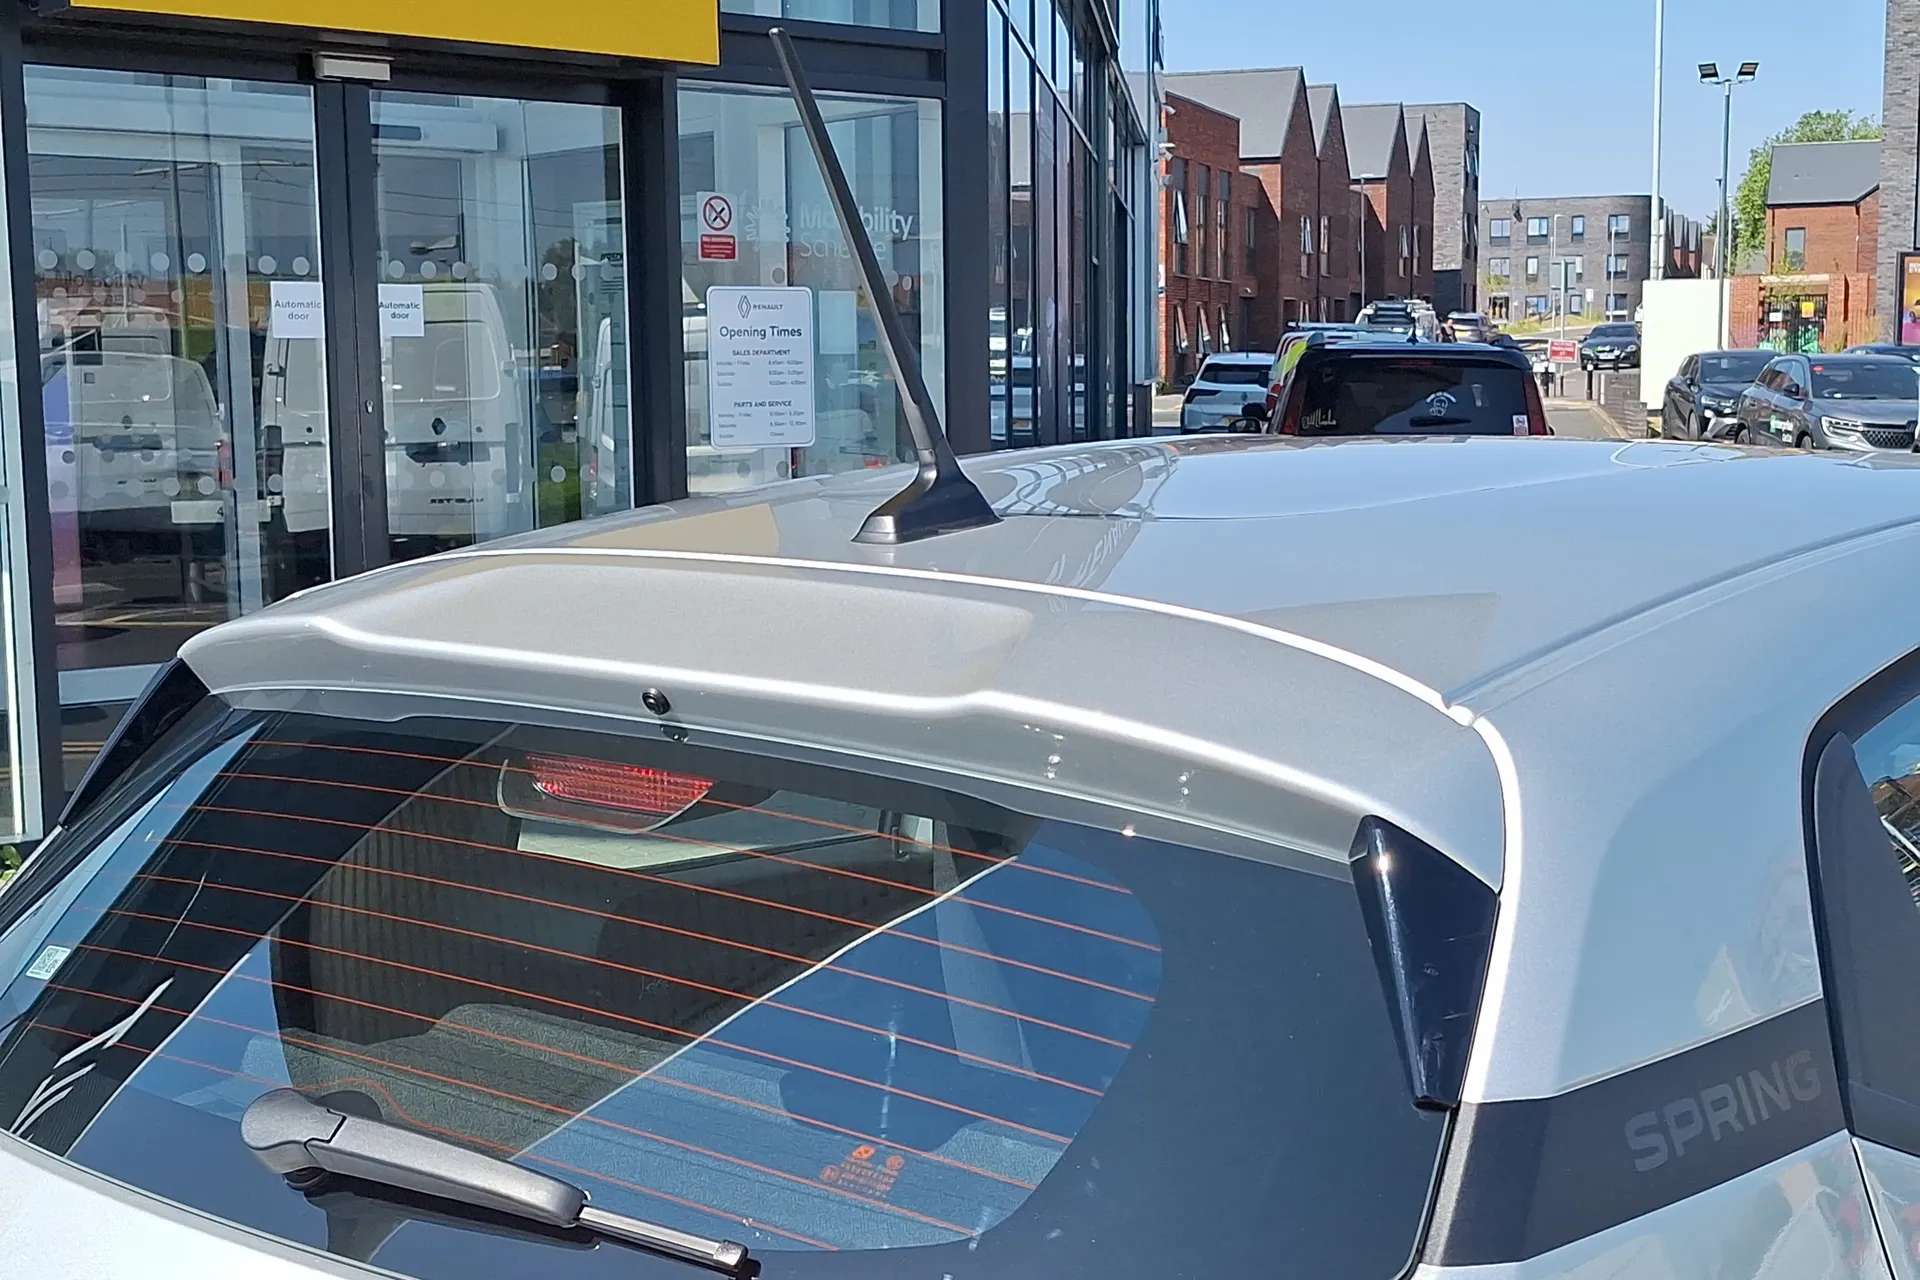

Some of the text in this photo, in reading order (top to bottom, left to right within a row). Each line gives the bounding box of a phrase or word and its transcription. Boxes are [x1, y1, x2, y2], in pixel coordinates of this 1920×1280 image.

[800, 204, 914, 241] Mobility
[800, 232, 887, 260] Schee
[274, 300, 322, 309] Automatic
[379, 302, 421, 310] Automatic
[287, 311, 310, 320] door
[390, 311, 409, 319] door
[719, 325, 802, 340] Opening Times
[1624, 1051, 1822, 1172] SPRING
